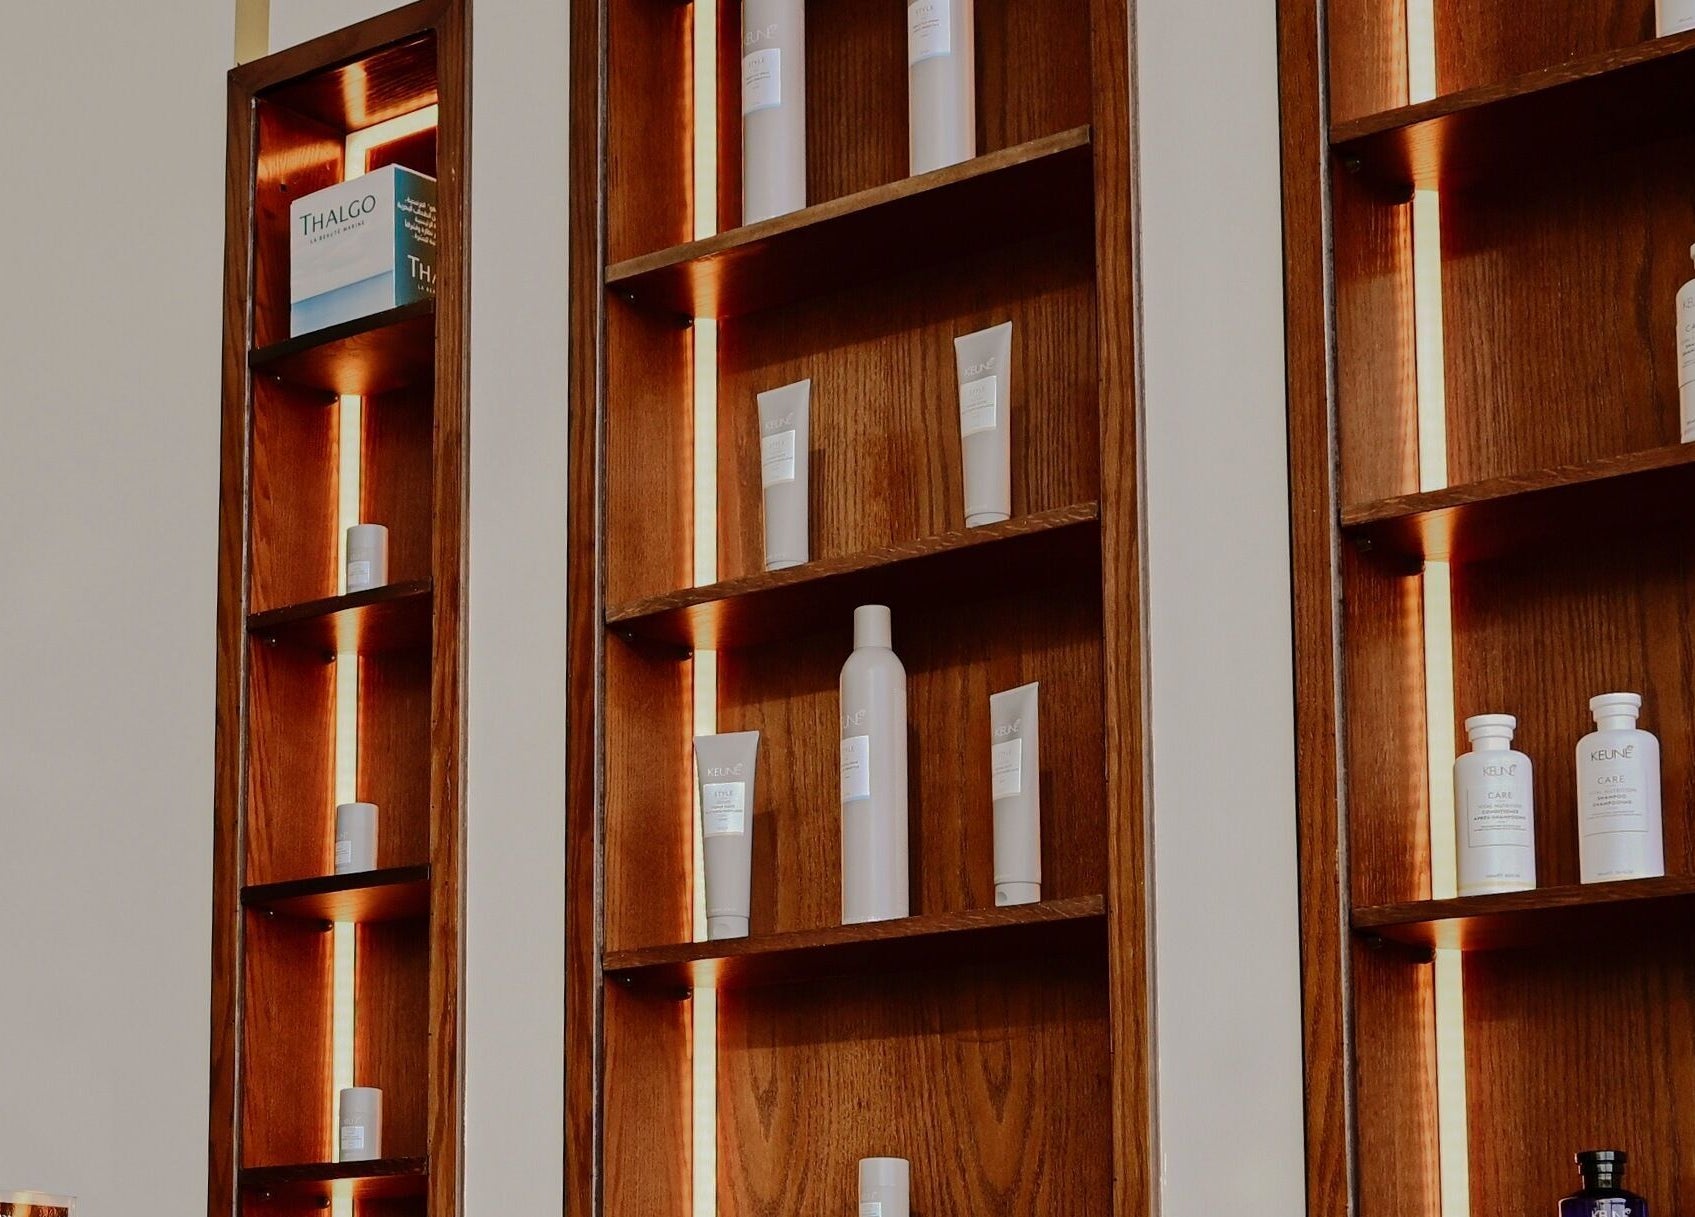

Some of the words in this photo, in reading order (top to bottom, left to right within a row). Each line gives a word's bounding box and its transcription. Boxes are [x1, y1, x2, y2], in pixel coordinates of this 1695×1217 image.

[300, 195, 376, 235] THALGO
[1590, 745, 1633, 761] KEUNE
[1483, 764, 1516, 777] KEUNE
[1597, 775, 1625, 785] CARE
[1488, 791, 1513, 800] CARE
